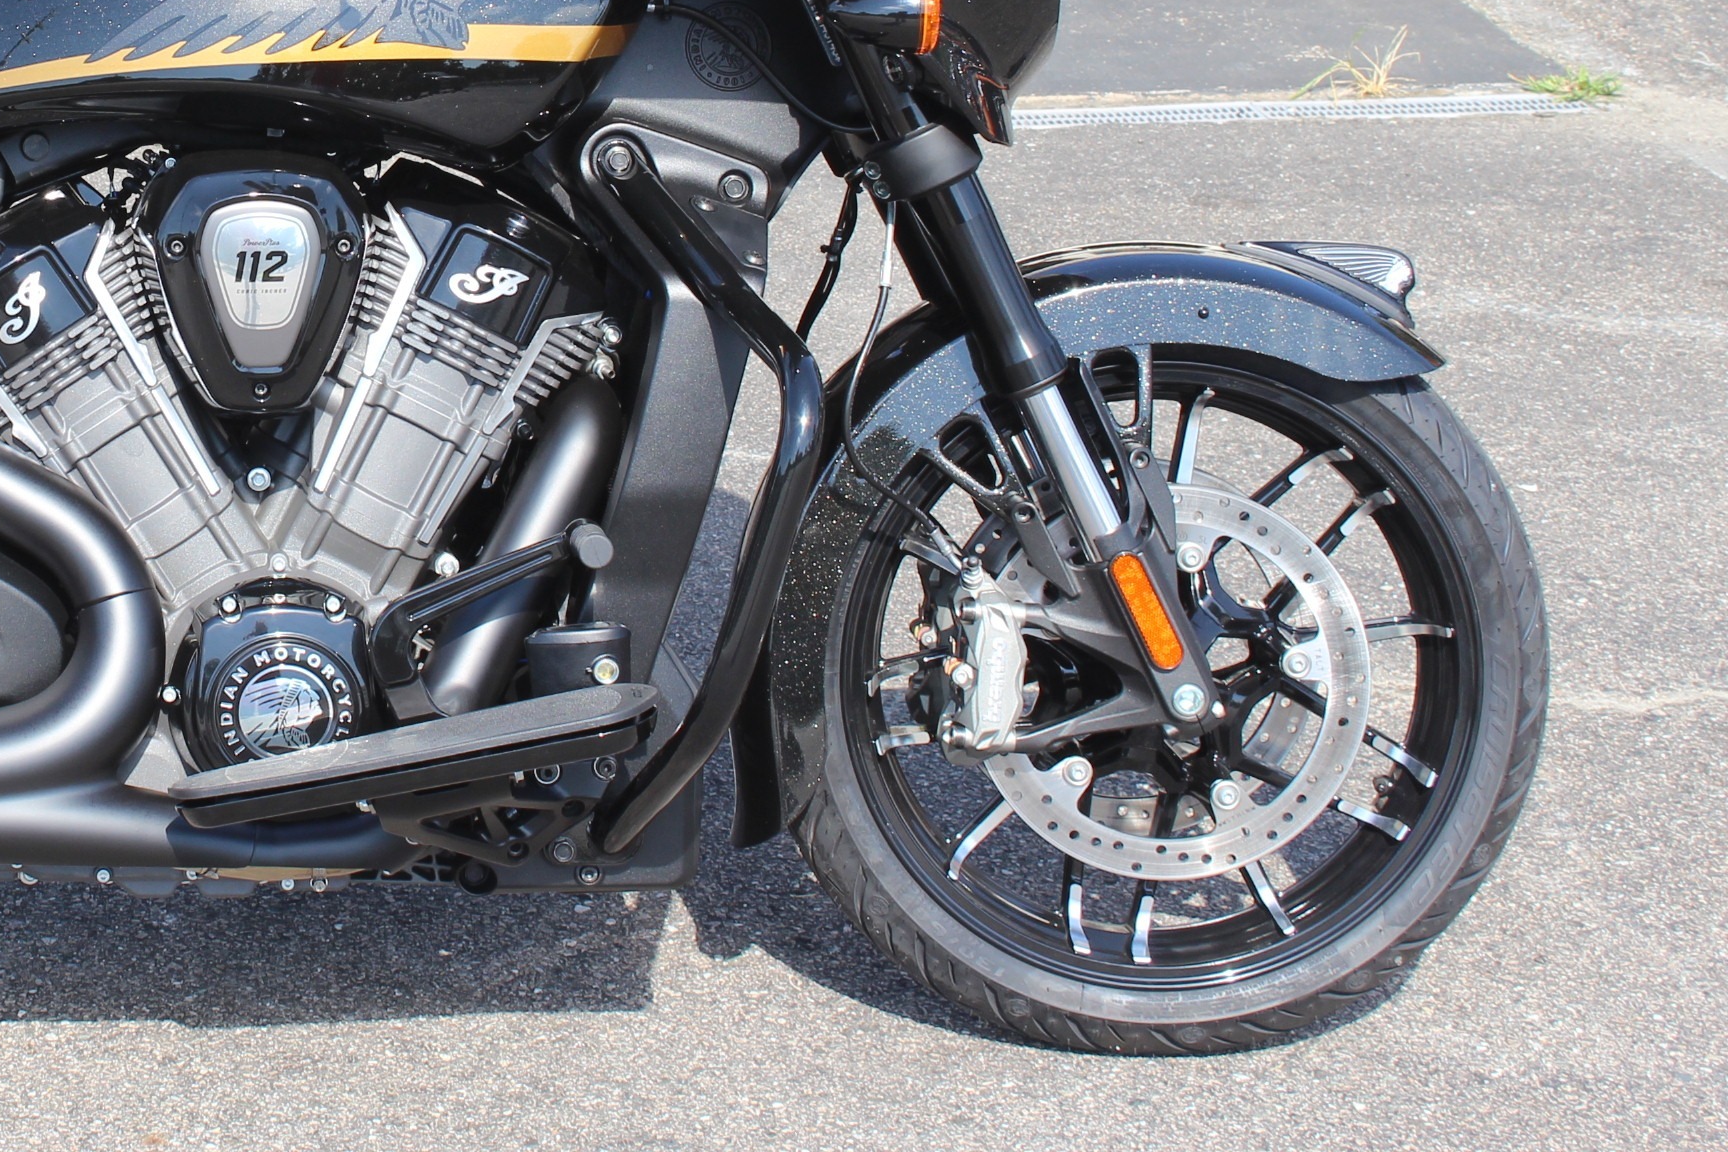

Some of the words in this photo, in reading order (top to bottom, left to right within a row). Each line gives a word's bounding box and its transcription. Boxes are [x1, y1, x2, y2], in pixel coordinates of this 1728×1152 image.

[234, 250, 289, 283] 112
[220, 666, 249, 756] INDIAN
[252, 646, 353, 738] MOTORCYCL
[983, 637, 1009, 722] brembo
